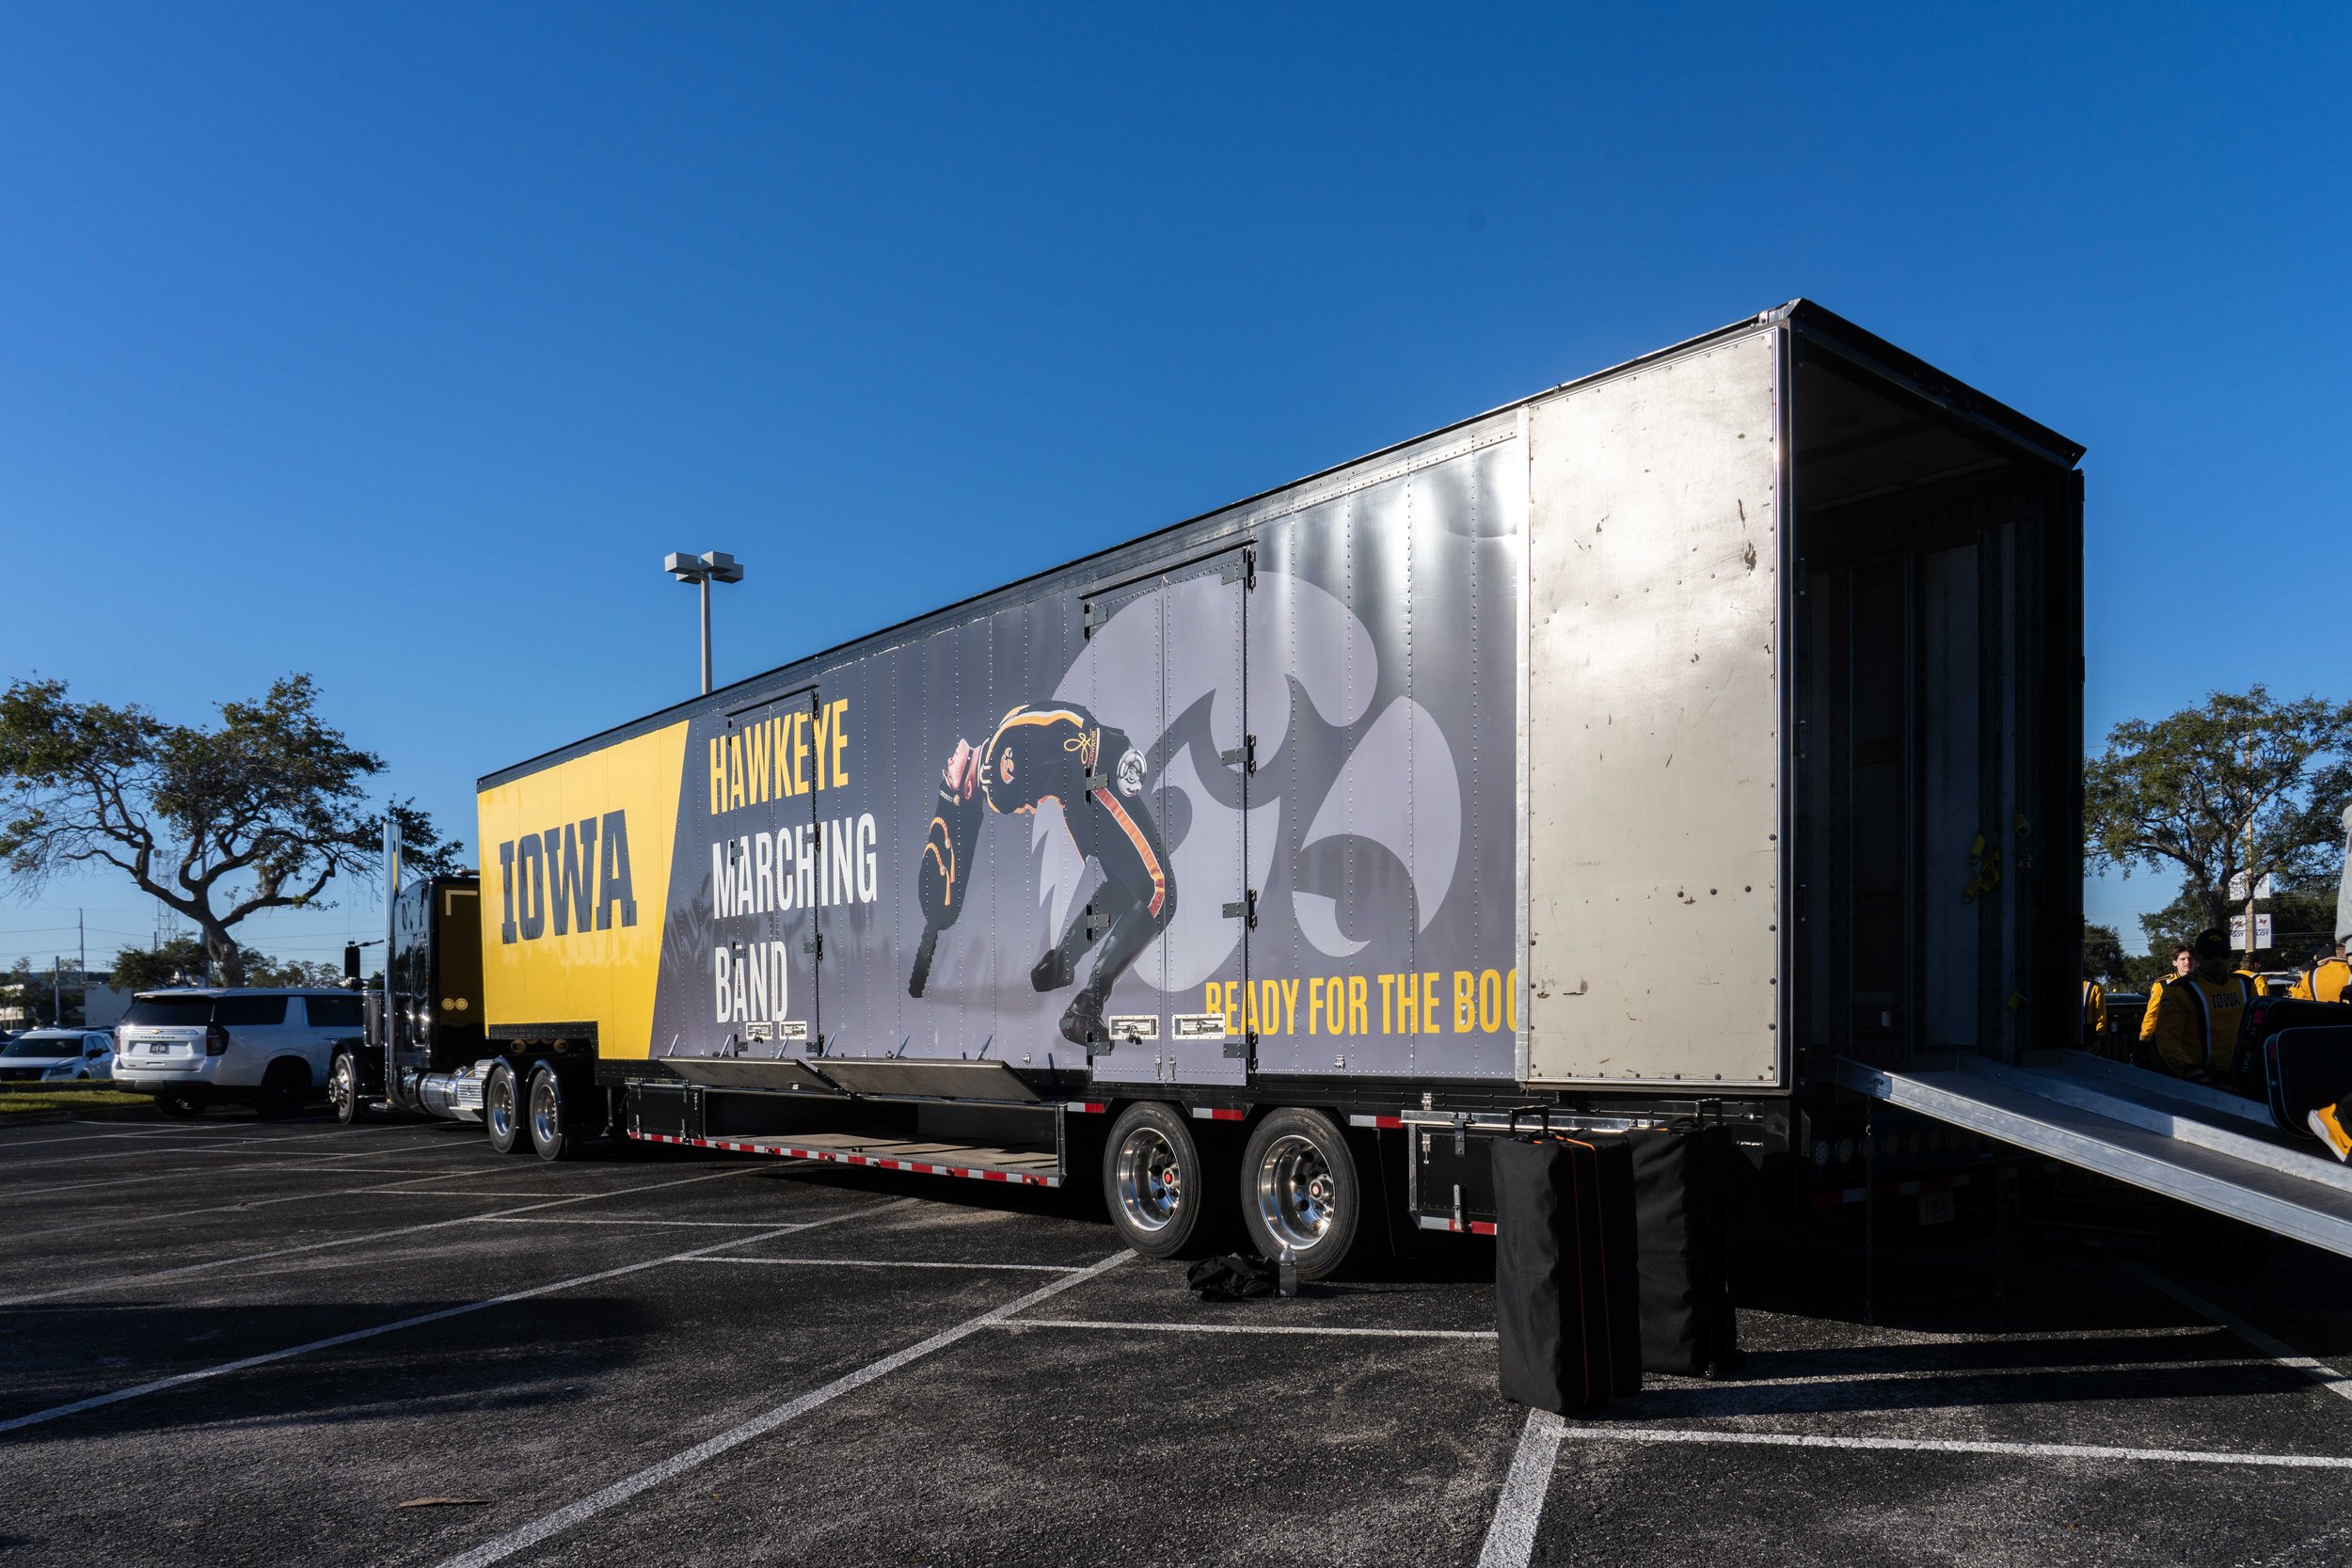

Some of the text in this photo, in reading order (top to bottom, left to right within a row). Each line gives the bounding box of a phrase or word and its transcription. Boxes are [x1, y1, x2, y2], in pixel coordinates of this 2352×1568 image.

[709, 699, 849, 816] HAWKEYE
[500, 809, 637, 944] IOWA
[712, 813, 877, 919] MARCHING
[715, 942, 787, 1023] BAND
[1205, 979, 1299, 1035] READY
[1309, 976, 1368, 1035] FOR
[1377, 973, 1439, 1035] THE
[2212, 992, 2241, 1008] IOWA
